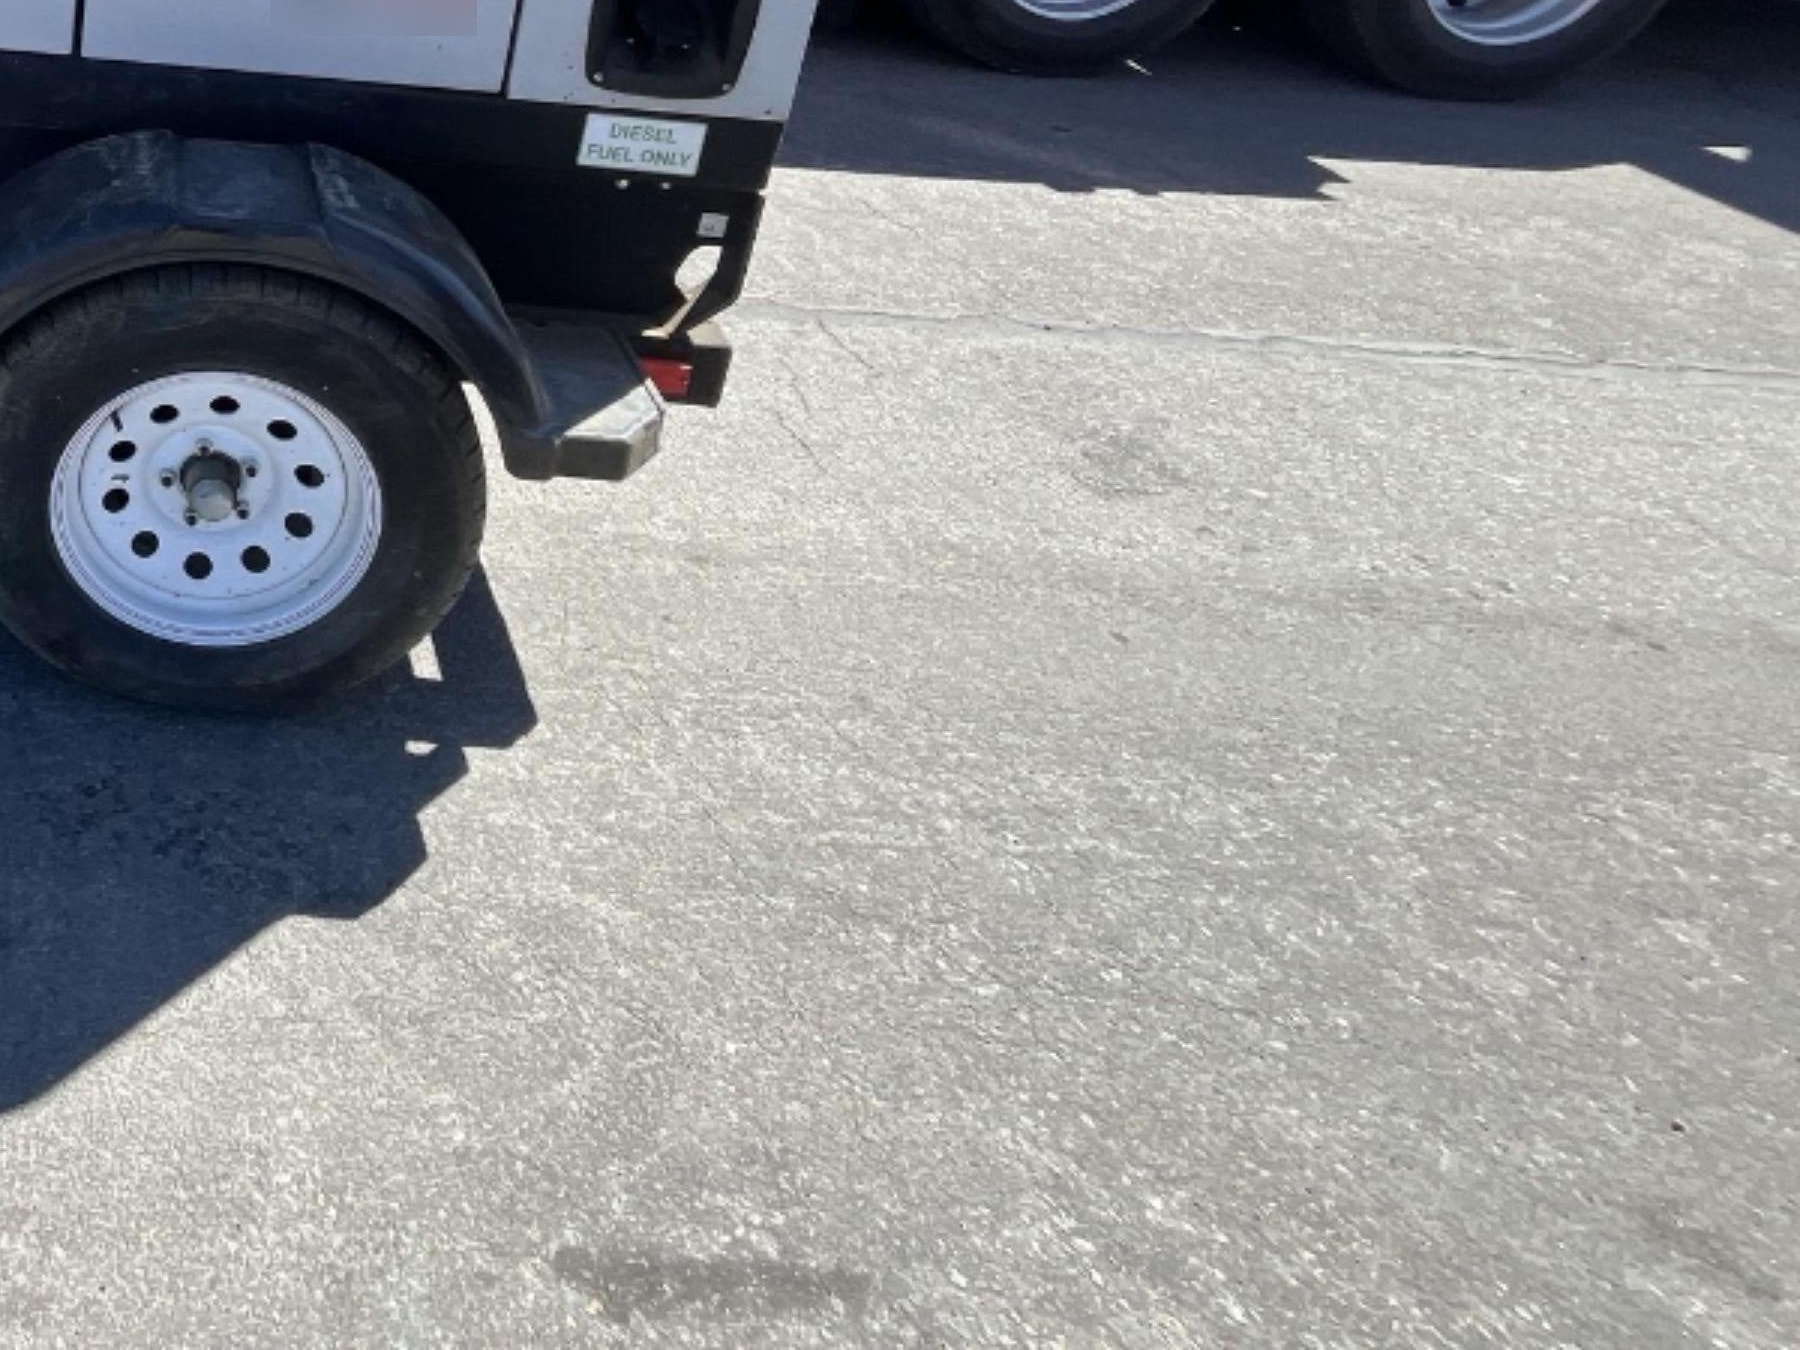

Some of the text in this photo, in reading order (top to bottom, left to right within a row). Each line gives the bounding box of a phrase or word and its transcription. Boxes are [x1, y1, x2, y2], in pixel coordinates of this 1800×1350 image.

[608, 123, 678, 145] DIESEL
[586, 144, 695, 167] FUEL ONLY
